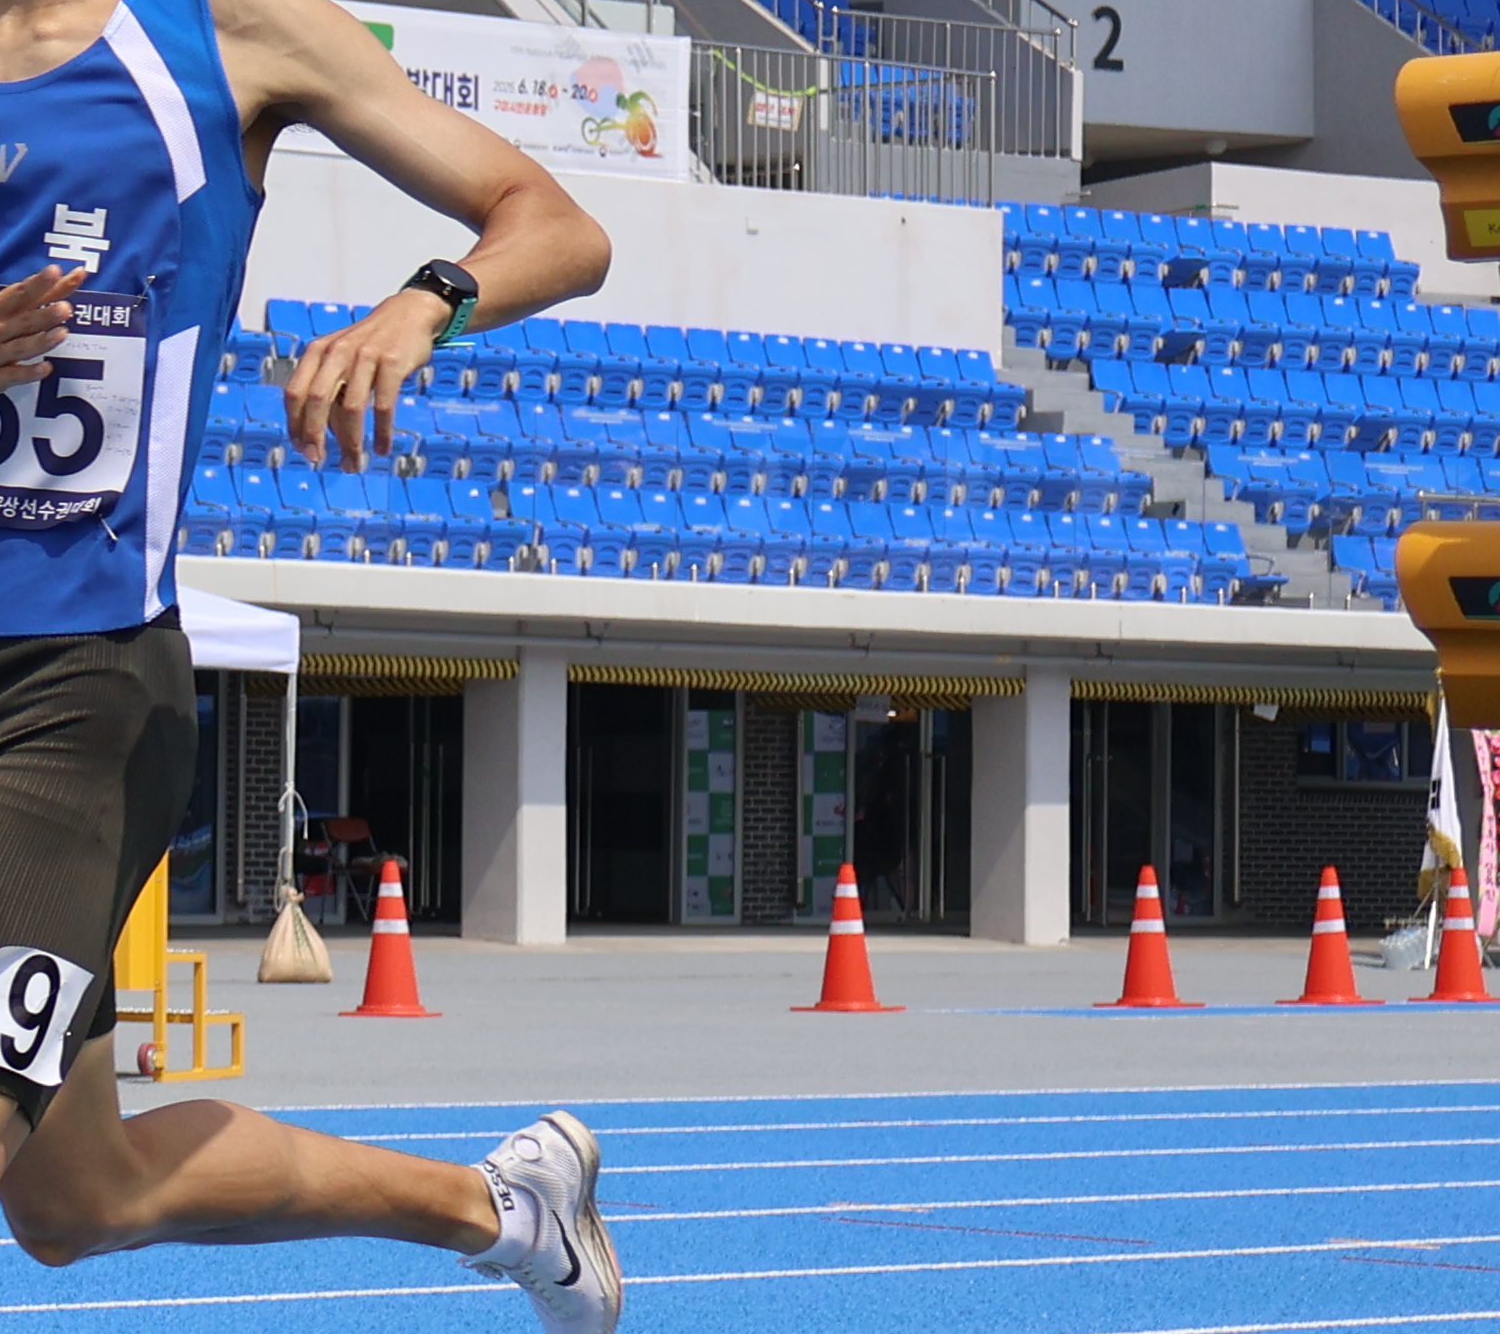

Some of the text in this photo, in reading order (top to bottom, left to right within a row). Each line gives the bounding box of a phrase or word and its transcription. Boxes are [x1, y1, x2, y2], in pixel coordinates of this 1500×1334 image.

[1091, 5, 1124, 72] 2
[43, 203, 111, 274] 북
[0, 953, 61, 1071] 9
